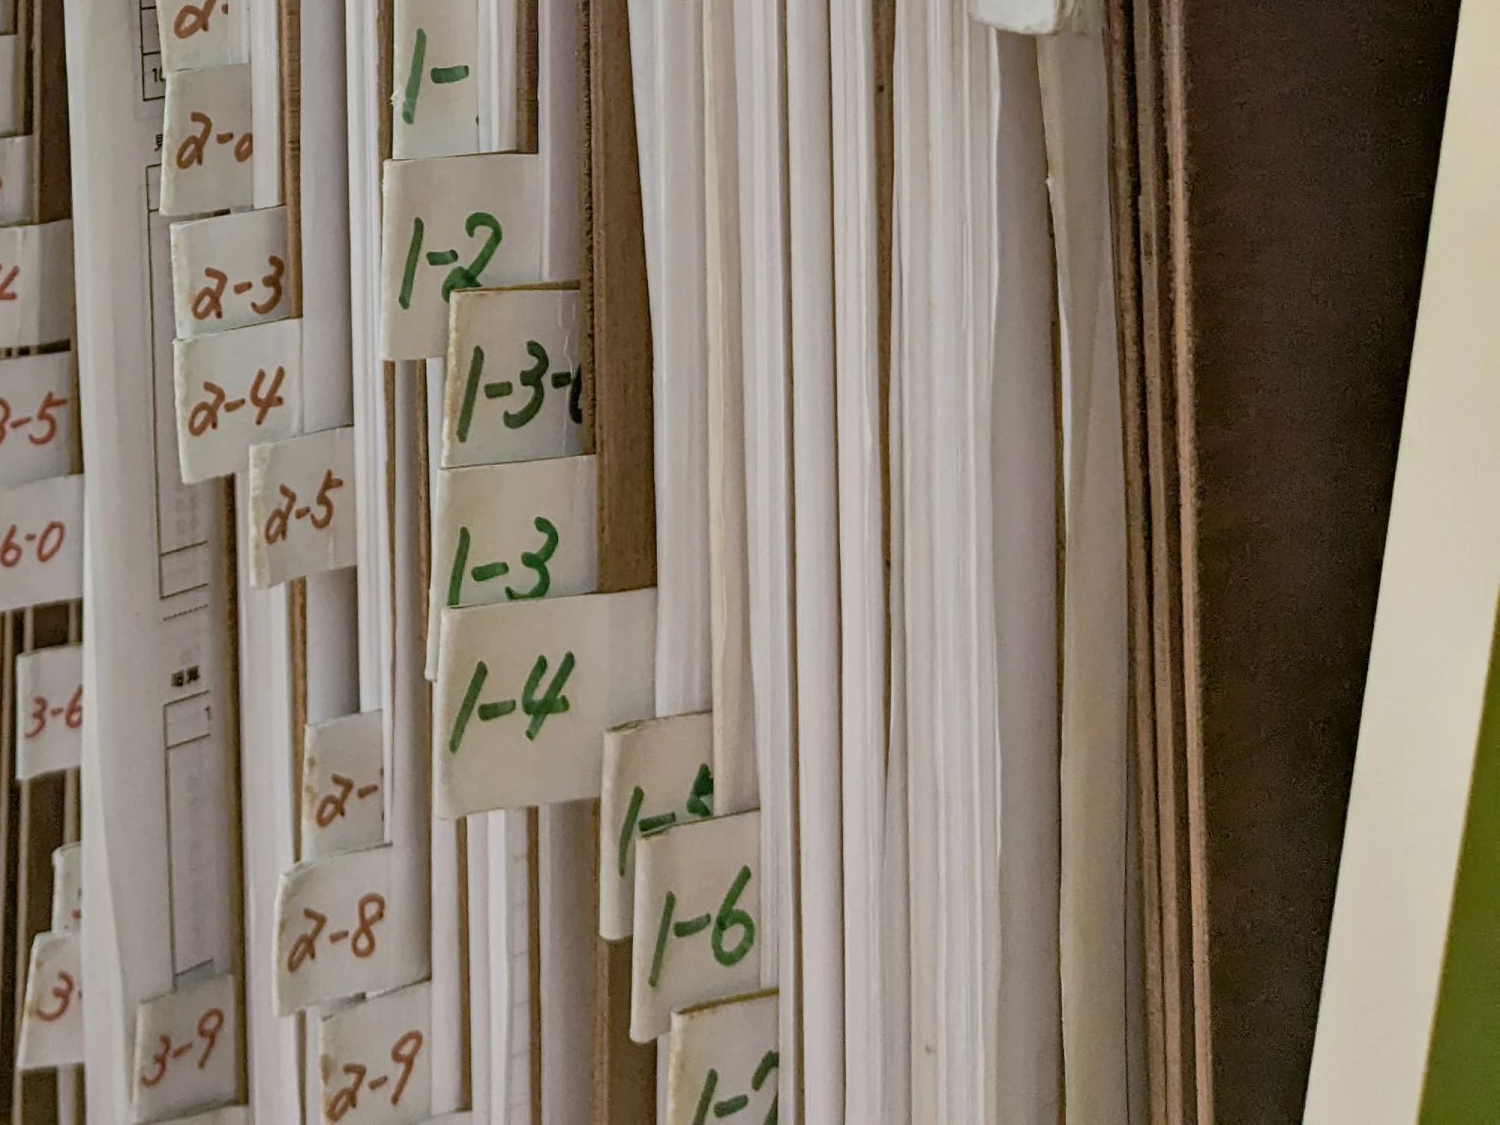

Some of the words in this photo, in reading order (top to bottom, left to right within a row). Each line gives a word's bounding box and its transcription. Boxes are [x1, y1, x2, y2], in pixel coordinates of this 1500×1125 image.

[191, 255, 286, 320] 2-3
[399, 212, 503, 310] 1-2
[188, 366, 286, 437] 2-4
[264, 469, 344, 545] 2-5
[448, 516, 559, 607] 1-3
[448, 651, 577, 754] 1-4
[287, 893, 387, 973] 2-8
[649, 865, 756, 988] 1-6
[141, 1008, 225, 1088] 3-9
[323, 1030, 424, 1124] 2-9
